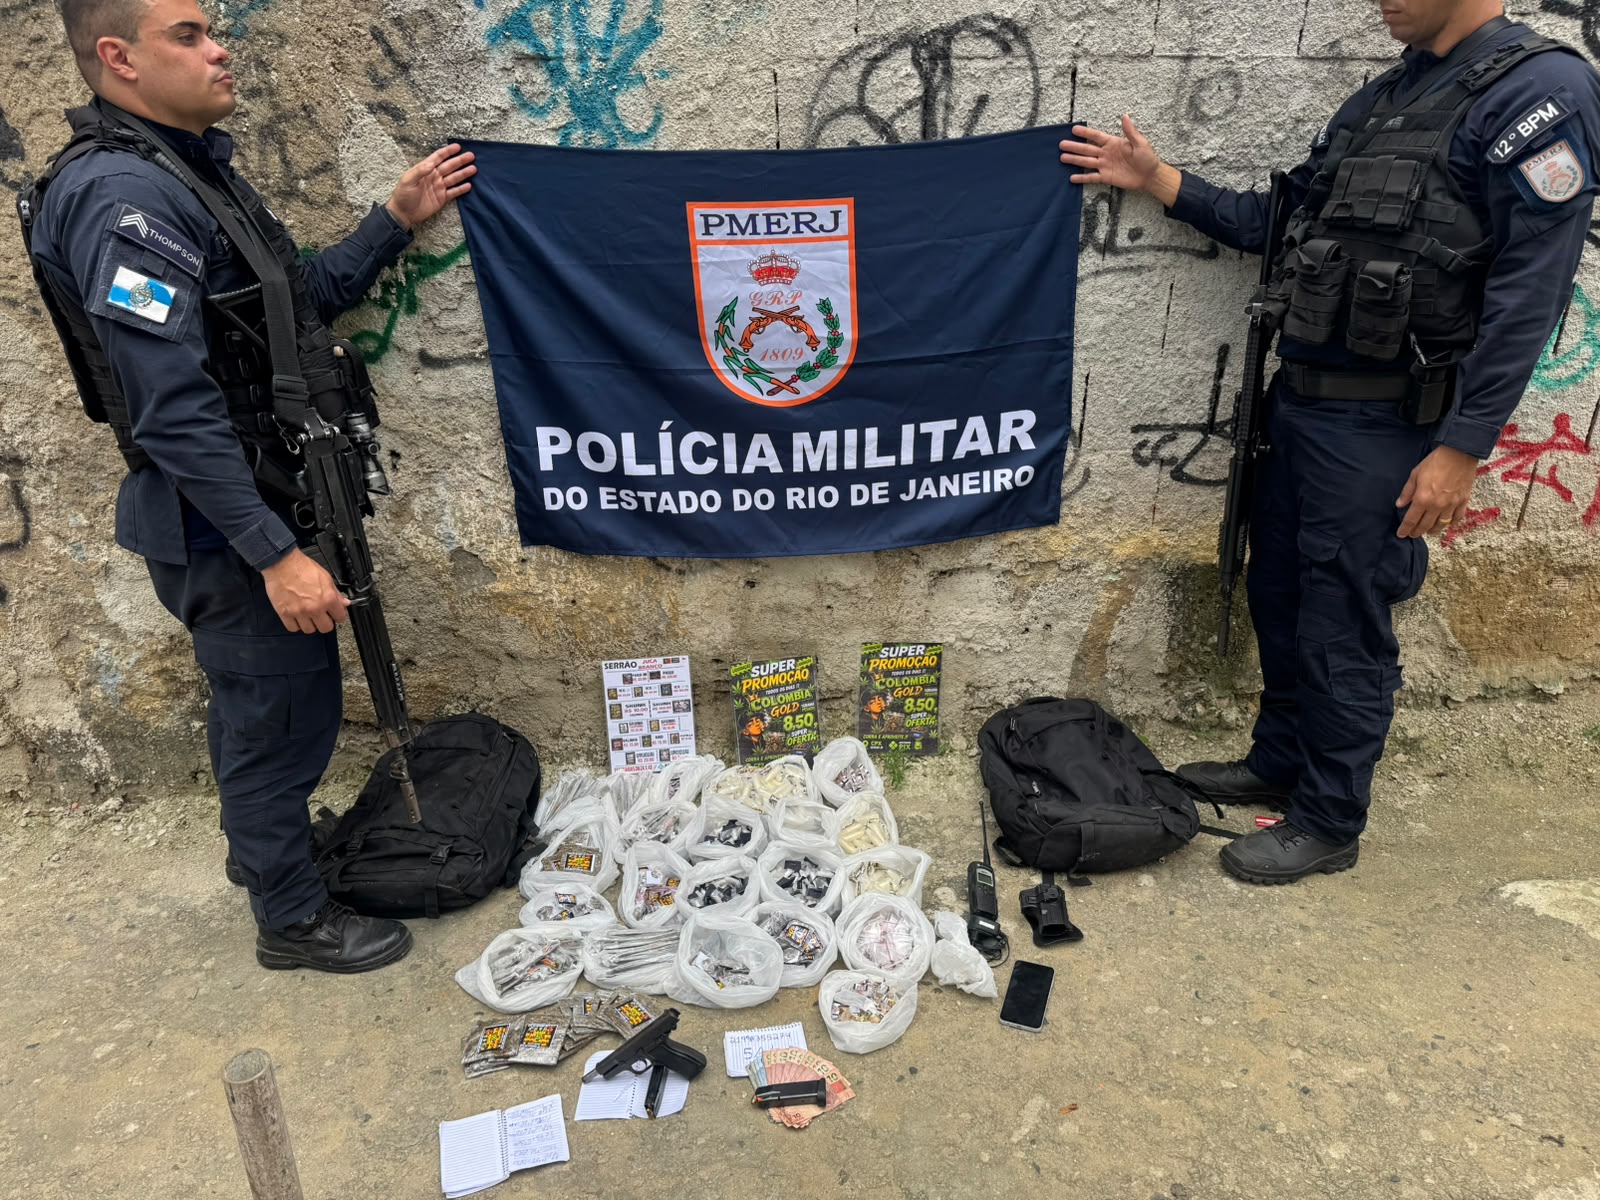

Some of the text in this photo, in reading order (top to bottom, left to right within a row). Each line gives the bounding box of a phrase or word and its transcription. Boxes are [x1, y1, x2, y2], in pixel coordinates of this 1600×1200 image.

[1516, 102, 1560, 138] BPM
[1526, 144, 1565, 170] PMERJ
[700, 209, 842, 238] PMERJ
[149, 228, 200, 267] THOMPSON
[749, 289, 803, 307] GRP
[760, 347, 804, 362] 1809
[536, 409, 1037, 476] POLÍCIA MILITAR
[543, 465, 1036, 514] DO ESTADO DO RIO DE JANEIRO
[880, 644, 926, 659] SUPER
[604, 660, 638, 670] SERRÃO
[750, 658, 796, 678] SUPER
[741, 667, 810, 694] PROMOÇÃO
[875, 676, 936, 690] COLOMBIA
[750, 689, 812, 712] COLOMBIA
[893, 686, 924, 698] GOLD
[770, 702, 800, 718] GOLD
[791, 728, 808, 737] SUPER
[817, 1064, 829, 1075] 10
[826, 1072, 839, 1082] 10
